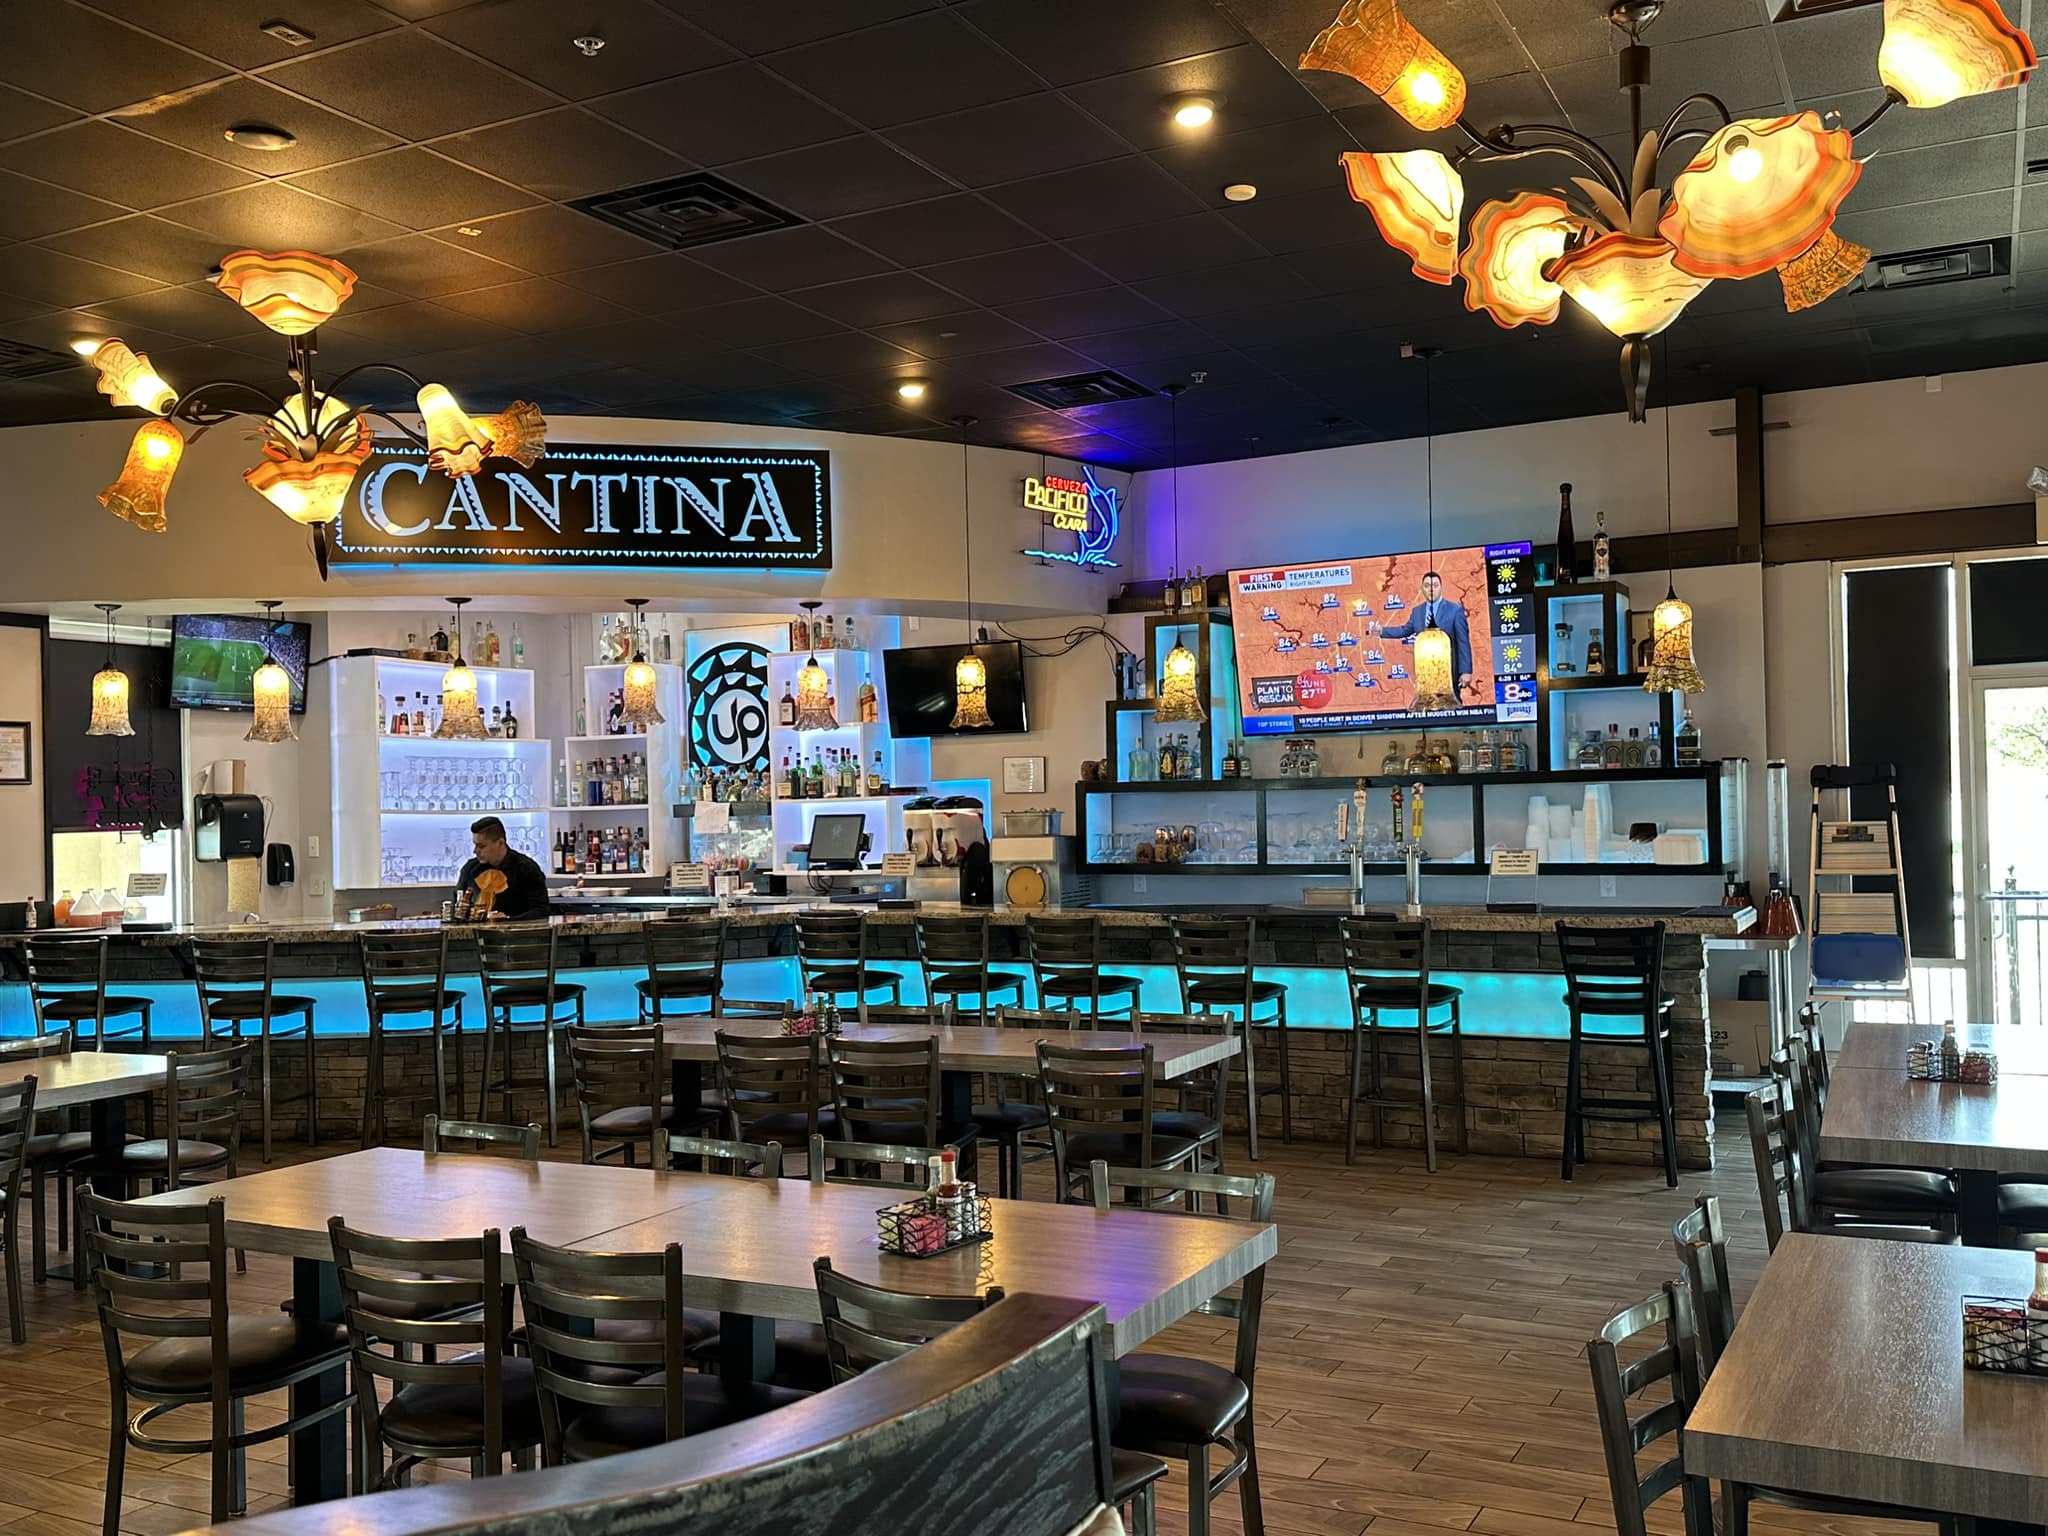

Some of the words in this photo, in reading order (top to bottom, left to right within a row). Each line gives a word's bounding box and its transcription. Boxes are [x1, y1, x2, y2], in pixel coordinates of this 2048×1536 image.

[1045, 475, 1088, 495] CERVEZA
[1024, 477, 1089, 514] PACIFICO
[359, 461, 802, 543] CANTINA
[1053, 512, 1088, 532] CLARA
[1249, 572, 1274, 584] FIRST
[1289, 568, 1350, 581] TEMPERATURES
[1243, 581, 1282, 592] WARNING
[1290, 580, 1306, 588] RIGHT
[1307, 579, 1321, 587] NOW
[1497, 582, 1517, 594] 84°
[1323, 593, 1336, 603] 82
[1387, 594, 1401, 604] 84
[1263, 606, 1276, 616] 84
[1500, 622, 1520, 633] 82°
[1313, 632, 1325, 642] 84
[1340, 631, 1352, 641] 84
[1279, 637, 1291, 648] 84
[1368, 649, 1380, 660] 84
[1315, 661, 1328, 671] 84
[1336, 657, 1348, 667] 87
[1391, 664, 1404, 674] 85
[1503, 662, 1523, 673] 84°
[1358, 672, 1371, 682] 83
[1301, 679, 1326, 688] JUNE
[1257, 686, 1280, 695] PLAN
[1282, 685, 1294, 694] TO
[1301, 688, 1326, 699] 27TH
[1504, 683, 1520, 700] 8
[1258, 694, 1294, 703] RESCAN
[1376, 712, 1406, 720] SHOOTING
[1269, 720, 1292, 728] STORIES
